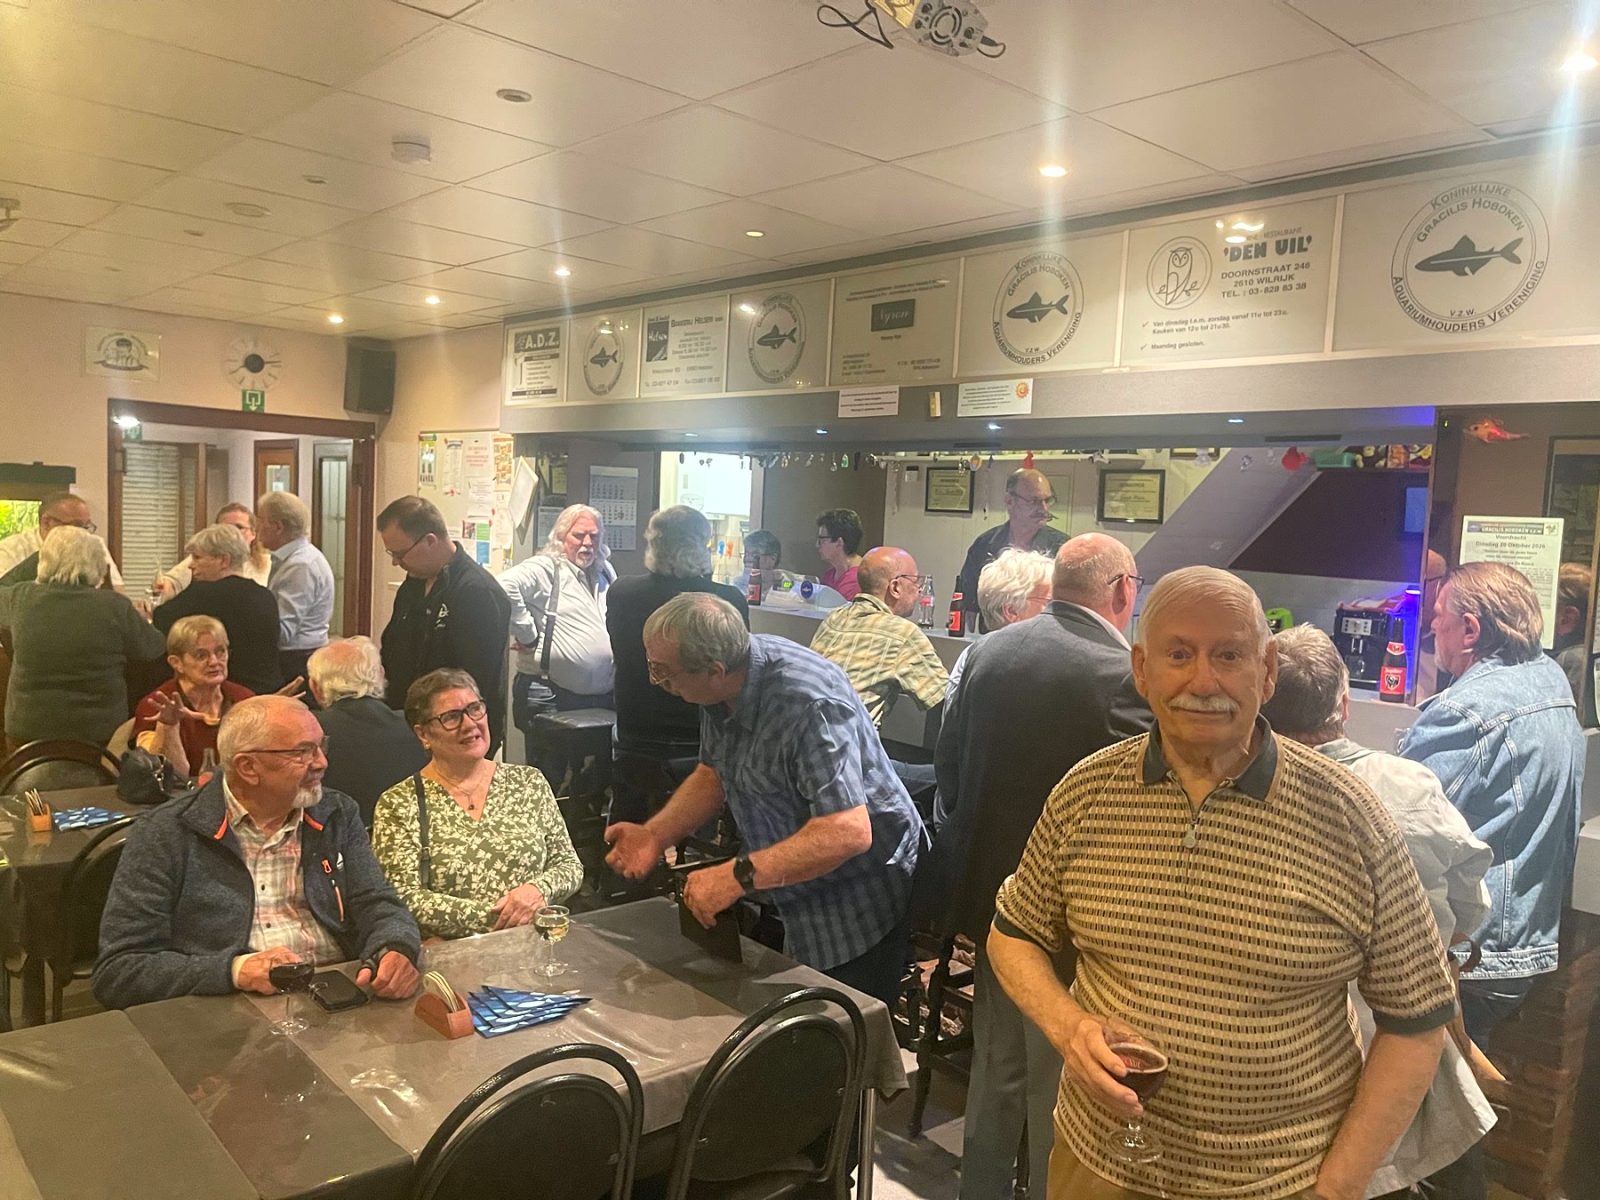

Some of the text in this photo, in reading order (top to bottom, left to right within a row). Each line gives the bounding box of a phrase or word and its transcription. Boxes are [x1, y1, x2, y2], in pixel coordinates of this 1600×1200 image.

[1430, 183, 1511, 210] KONINKLIJKE
[1416, 198, 1525, 243] GRACILIS HOBOKEN
[1007, 264, 1038, 296] GRACILIS
[1221, 265, 1292, 280] DOORNSTRAAT
[1257, 274, 1295, 285] WILRIJK
[1221, 289, 1240, 298] TEL.
[1392, 260, 1544, 332] AQUARIUMHOUDERS VERENIGING
[524, 331, 560, 349] A.D.Z.
